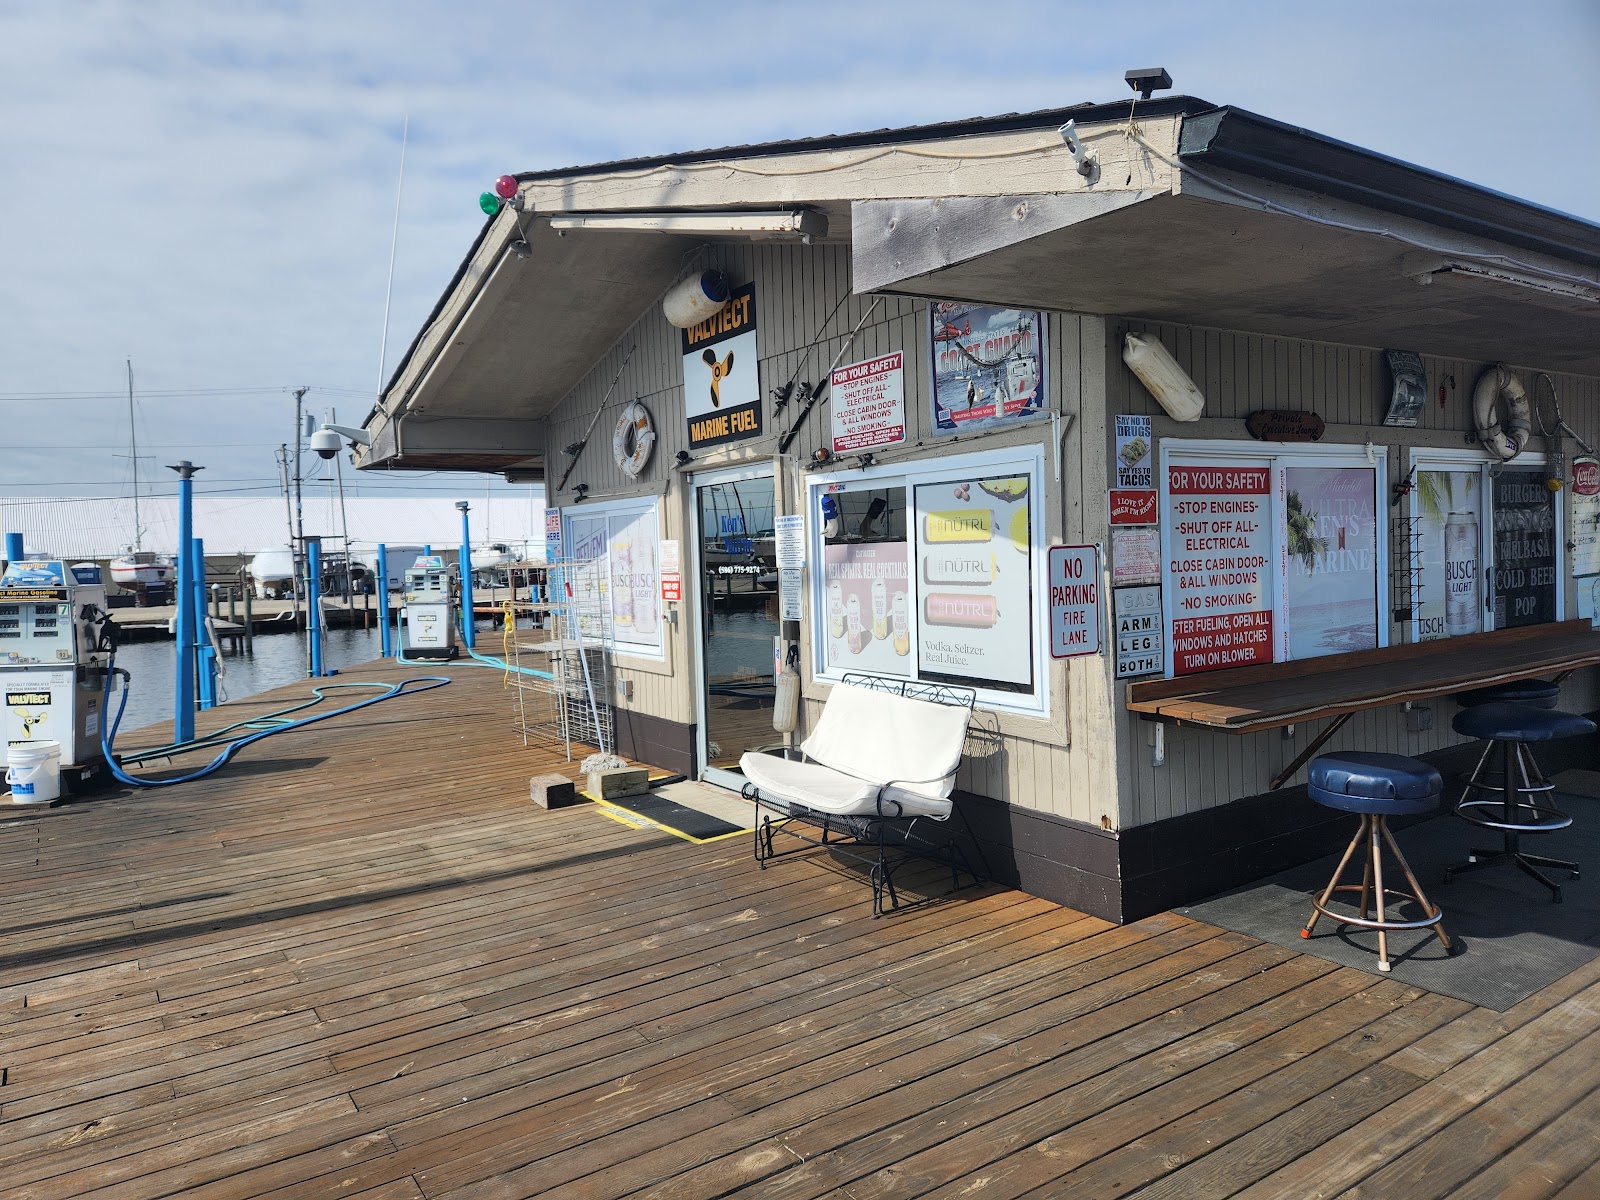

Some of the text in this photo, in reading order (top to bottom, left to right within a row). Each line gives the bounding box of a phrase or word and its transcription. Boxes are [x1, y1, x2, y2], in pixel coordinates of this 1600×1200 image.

[985, 330, 1032, 360] GUARD
[833, 356, 900, 384] FOR YOUR SAFETY
[862, 386, 874, 396] OFF
[846, 392, 885, 407] ELECTRICAL
[848, 416, 860, 425] ALL
[860, 408, 892, 422] WINDOWS
[857, 404, 877, 415] CABIN
[1271, 412, 1303, 423] Private
[691, 415, 730, 443] MARINE
[730, 408, 758, 434] FUEL
[1116, 416, 1151, 426] SAY NO TO
[1117, 425, 1151, 437] DRUGS
[835, 435, 852, 444] AFTER
[838, 438, 862, 447] WINDOWS
[873, 432, 899, 441] HATCHES
[1118, 467, 1151, 475] SAY YES TO
[1119, 474, 1151, 487] TACOS
[1191, 472, 1223, 489] YOUR
[1225, 472, 1266, 489] SAFETY
[1500, 483, 1548, 504] BURGERS
[1121, 497, 1137, 508] LOVE
[1137, 497, 1145, 506] IT
[1111, 506, 1129, 517] WHEN
[1129, 507, 1139, 516] I'M
[546, 515, 559, 527] LIFE
[721, 514, 744, 533] Ken's
[1211, 521, 1233, 534] OFF
[1495, 509, 1553, 531] HOT DOGS
[547, 532, 561, 541] HERE
[1186, 536, 1250, 551] ELECTRICAL
[1500, 539, 1551, 561] KIELBASA
[1064, 557, 1083, 579] NO
[1170, 559, 1203, 573] CLOSE
[1205, 557, 1235, 571] CABIN
[1296, 548, 1371, 576] MARINE
[1446, 560, 1477, 580] BUSCH
[828, 562, 841, 580] REAL
[863, 562, 877, 579] REAL
[1209, 571, 1257, 587] WINDOWS
[1495, 566, 1556, 590] COLD BEER
[630, 573, 656, 589] BUSCH
[1452, 581, 1473, 593] LIGHT
[635, 590, 652, 598] LIGHT
[1052, 583, 1096, 606] PARKING
[1123, 592, 1155, 609] GAS
[58, 604, 68, 615] 7
[1514, 596, 1537, 617] POP
[1063, 610, 1086, 626] FIRE
[1121, 617, 1151, 632] ARM
[1173, 612, 1270, 635] FTER FUELING, OPEN ALL
[1419, 616, 1444, 634] USCH
[1062, 629, 1088, 645] LANE
[1121, 637, 1151, 652] LEG
[1214, 633, 1232, 647] AND
[1233, 629, 1268, 645] HATCHES
[924, 640, 985, 656] Vodka. Seltzer.
[925, 651, 969, 666] Real Juice.
[1120, 658, 1153, 673] BOTH
[1184, 647, 1257, 669] TURN ON BLOWER.
[8, 693, 49, 705] VALVTECT
